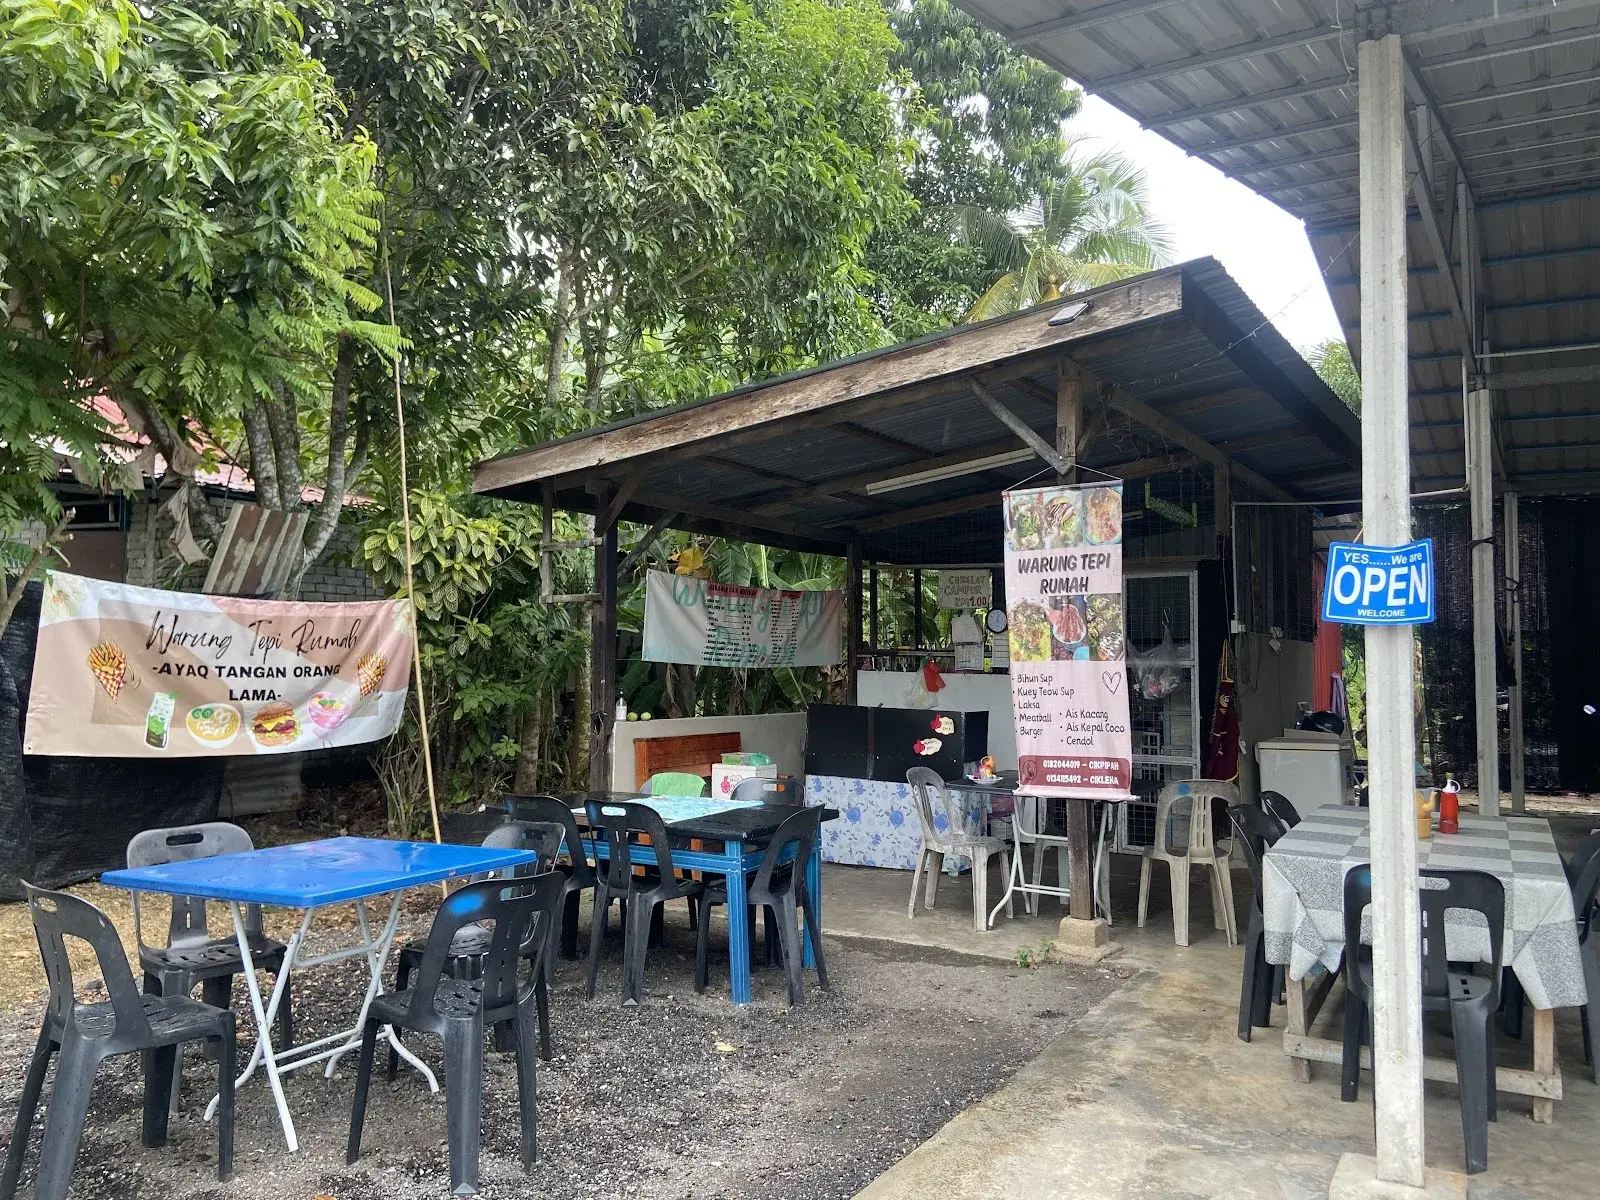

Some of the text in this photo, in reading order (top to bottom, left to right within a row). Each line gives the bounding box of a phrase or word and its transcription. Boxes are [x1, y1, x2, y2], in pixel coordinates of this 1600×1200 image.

[1018, 553, 1111, 574] WARUNG TEPI
[1409, 552, 1423, 563] are
[1040, 576, 1089, 595] RUMAH
[1333, 563, 1428, 607] OPEN
[1357, 609, 1406, 617] WELCOME
[146, 611, 361, 665] Warung Tepi Rumah
[215, 666, 287, 678] TANGAN
[293, 664, 341, 677] ORANG
[1017, 673, 1053, 686] Bihun Sup
[1017, 686, 1075, 699] Kuey Teow Sup
[1018, 700, 1040, 709] Laksa
[1020, 713, 1052, 722] Meatball
[1065, 709, 1108, 722] Ais Kacang
[1020, 726, 1043, 739] Burger
[1066, 722, 1125, 735] Ais Kepal Coco
[1066, 736, 1094, 745] Cendol
[1089, 775, 1119, 785] CIKLEHA
